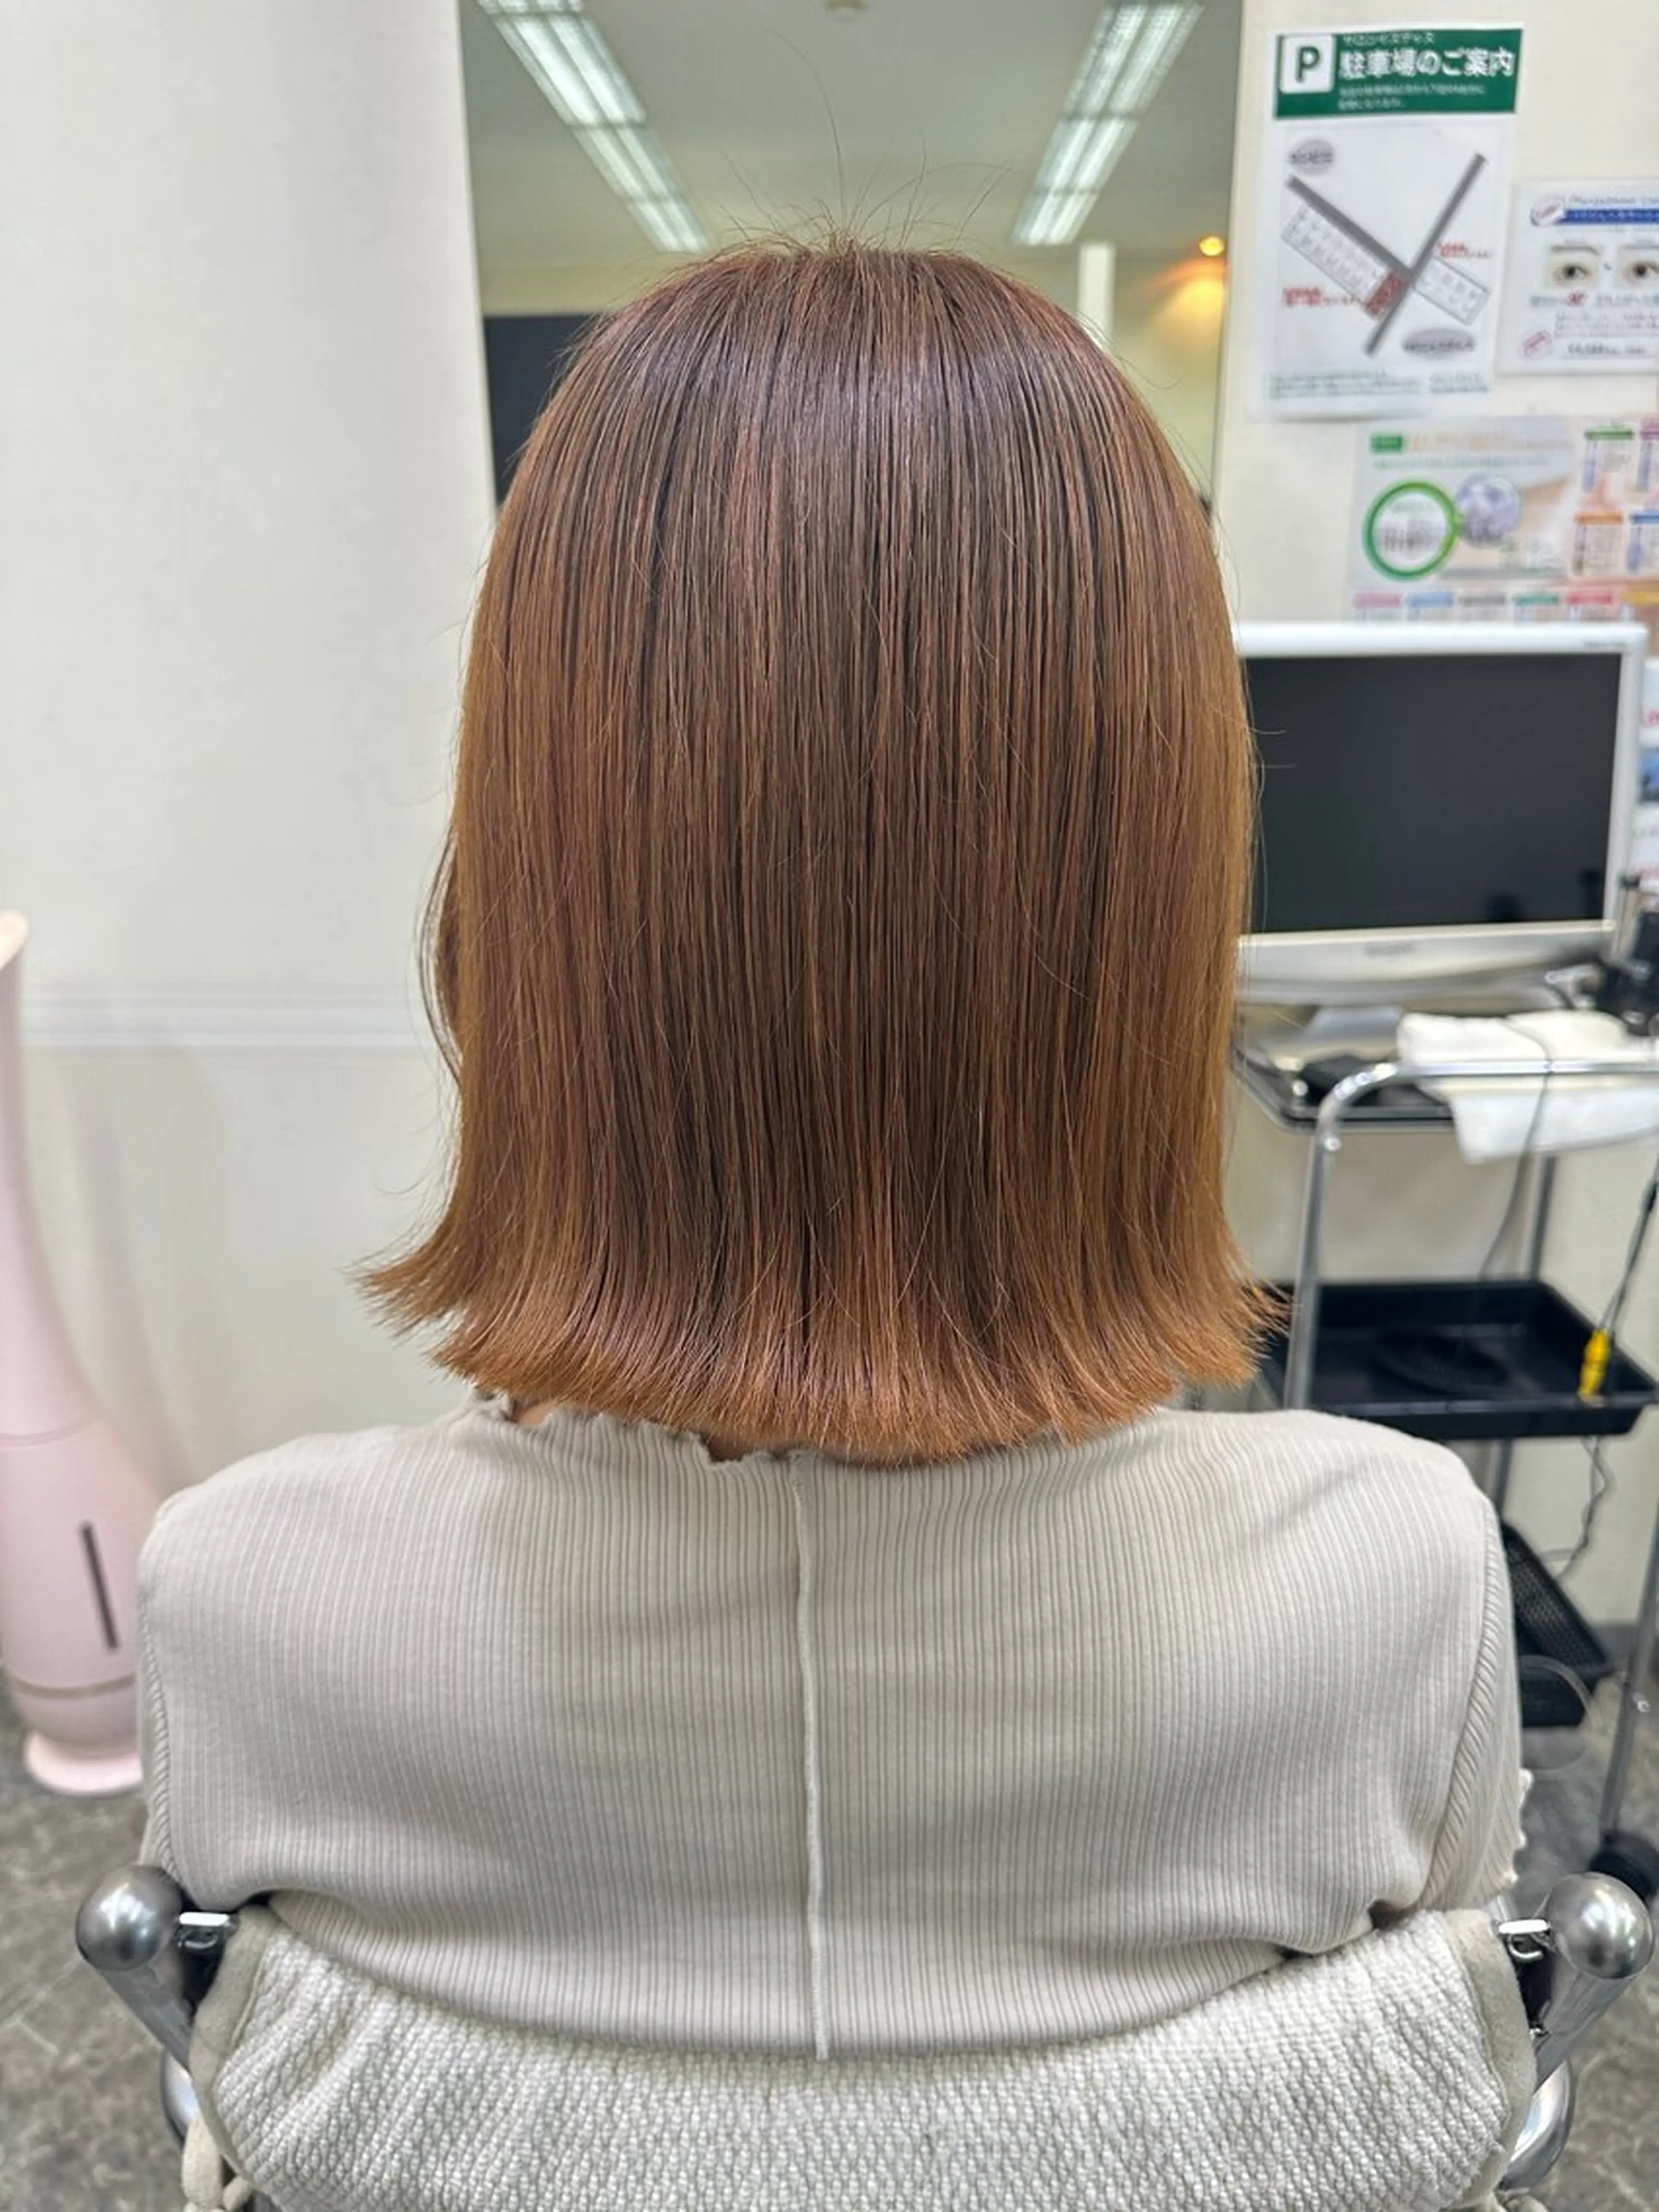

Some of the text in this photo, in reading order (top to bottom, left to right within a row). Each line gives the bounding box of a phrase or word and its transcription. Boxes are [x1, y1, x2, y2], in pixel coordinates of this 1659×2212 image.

[1295, 46, 1320, 83] P
[1339, 47, 1515, 79] 駐車場のご案内
